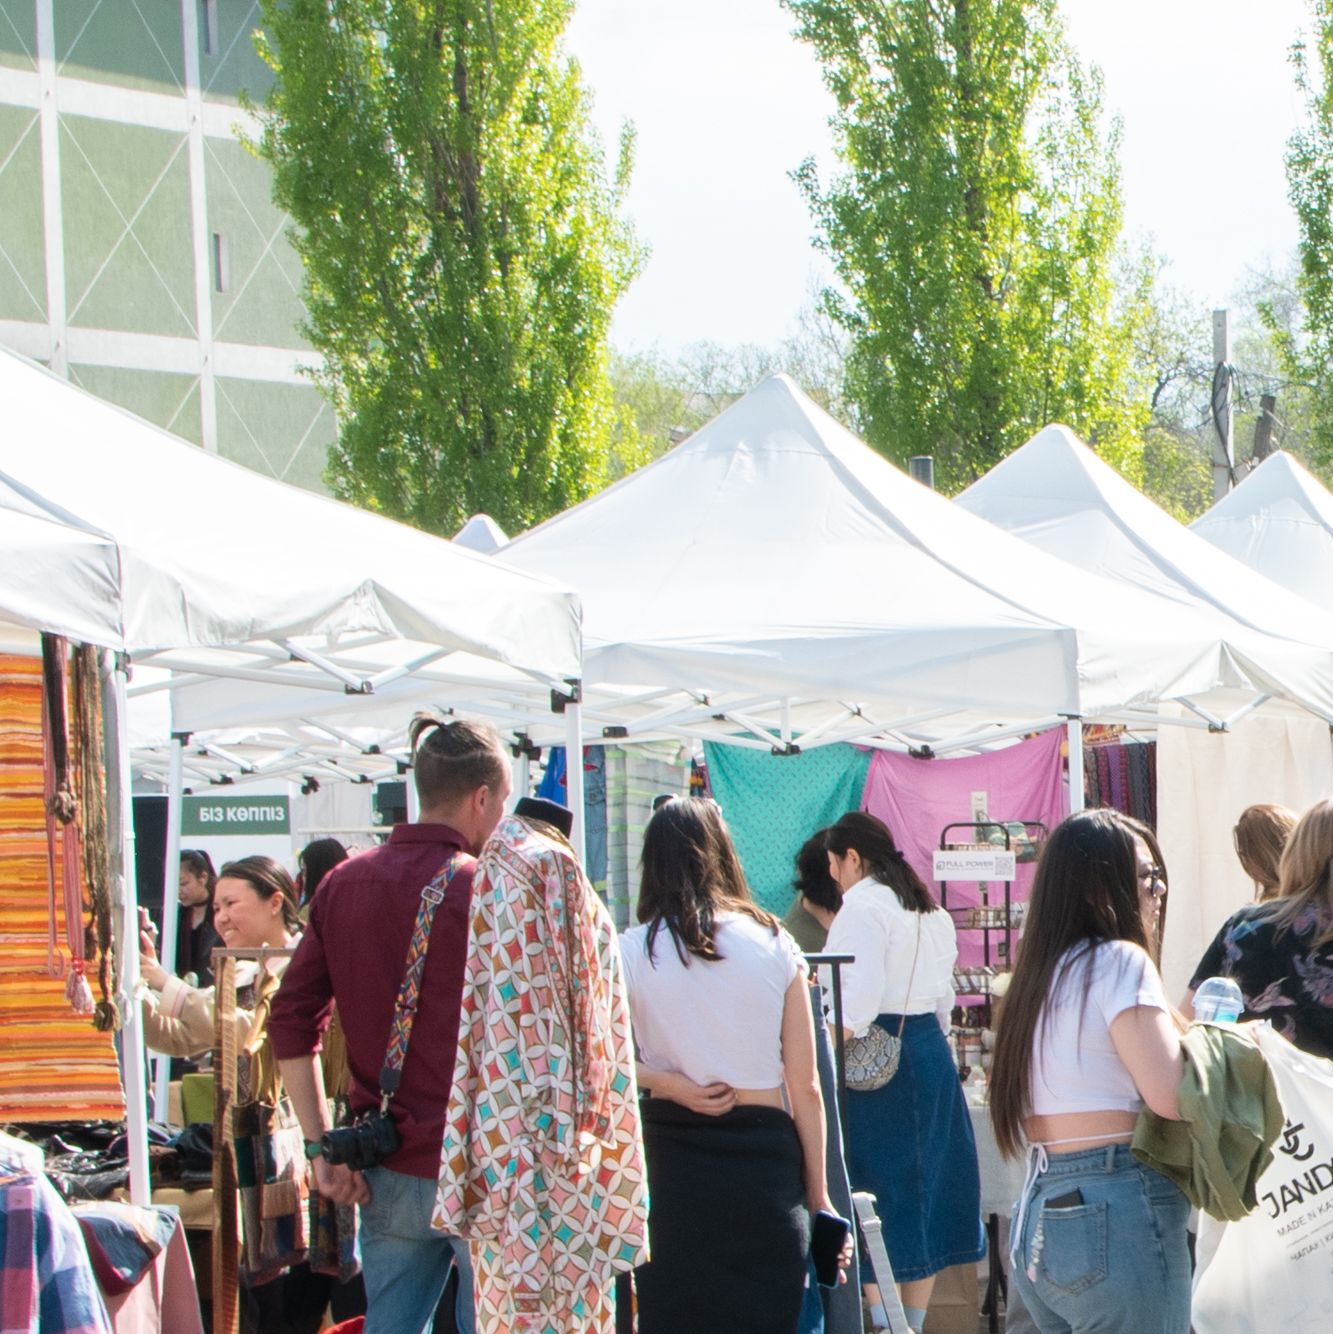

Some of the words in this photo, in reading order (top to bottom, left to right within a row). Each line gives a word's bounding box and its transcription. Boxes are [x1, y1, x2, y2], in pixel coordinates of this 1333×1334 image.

[200, 806, 223, 822] БІЗ
[226, 806, 285, 822] КӨППІЗ
[1277, 1217, 1308, 1237] MADE
